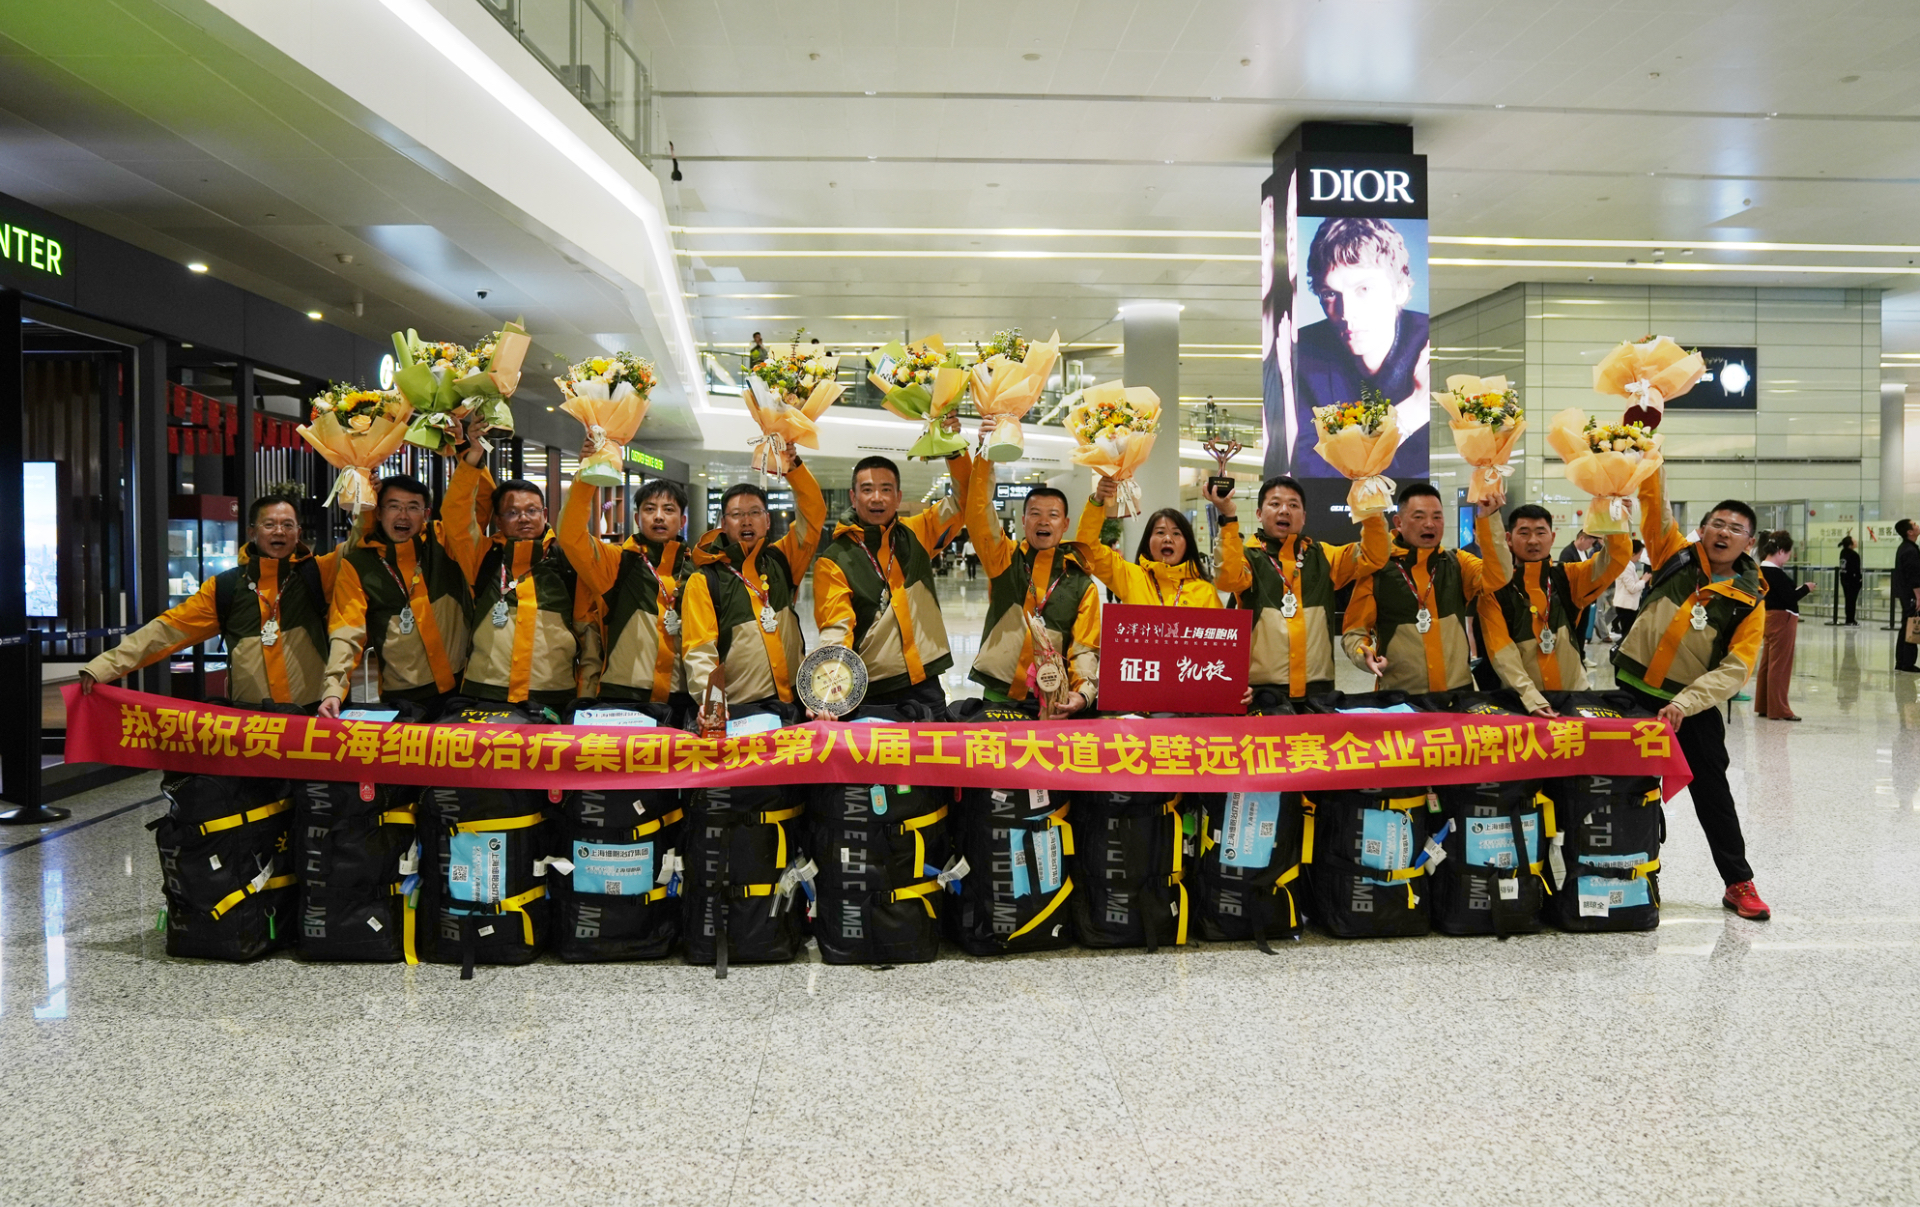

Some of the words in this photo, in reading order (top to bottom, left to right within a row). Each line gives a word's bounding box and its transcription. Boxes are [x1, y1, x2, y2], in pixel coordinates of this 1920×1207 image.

[1310, 168, 1415, 203] DIOR
[0, 223, 62, 276] NTER
[1180, 627, 1238, 640] 上海细胞队
[1120, 658, 1160, 682] 征8
[1176, 655, 1233, 683] 凯旋
[119, 704, 1671, 776] 热烈祝贺上海细胞治疗集团荣获第八届工商大道戈壁远征赛企业品牌队第一名
[705, 787, 731, 839] MAE
[1590, 822, 1613, 847] TO
[842, 848, 866, 874] TO
[304, 879, 327, 938] CIMB
[842, 881, 867, 939] CIMB
[992, 880, 1018, 934] CLIMB
